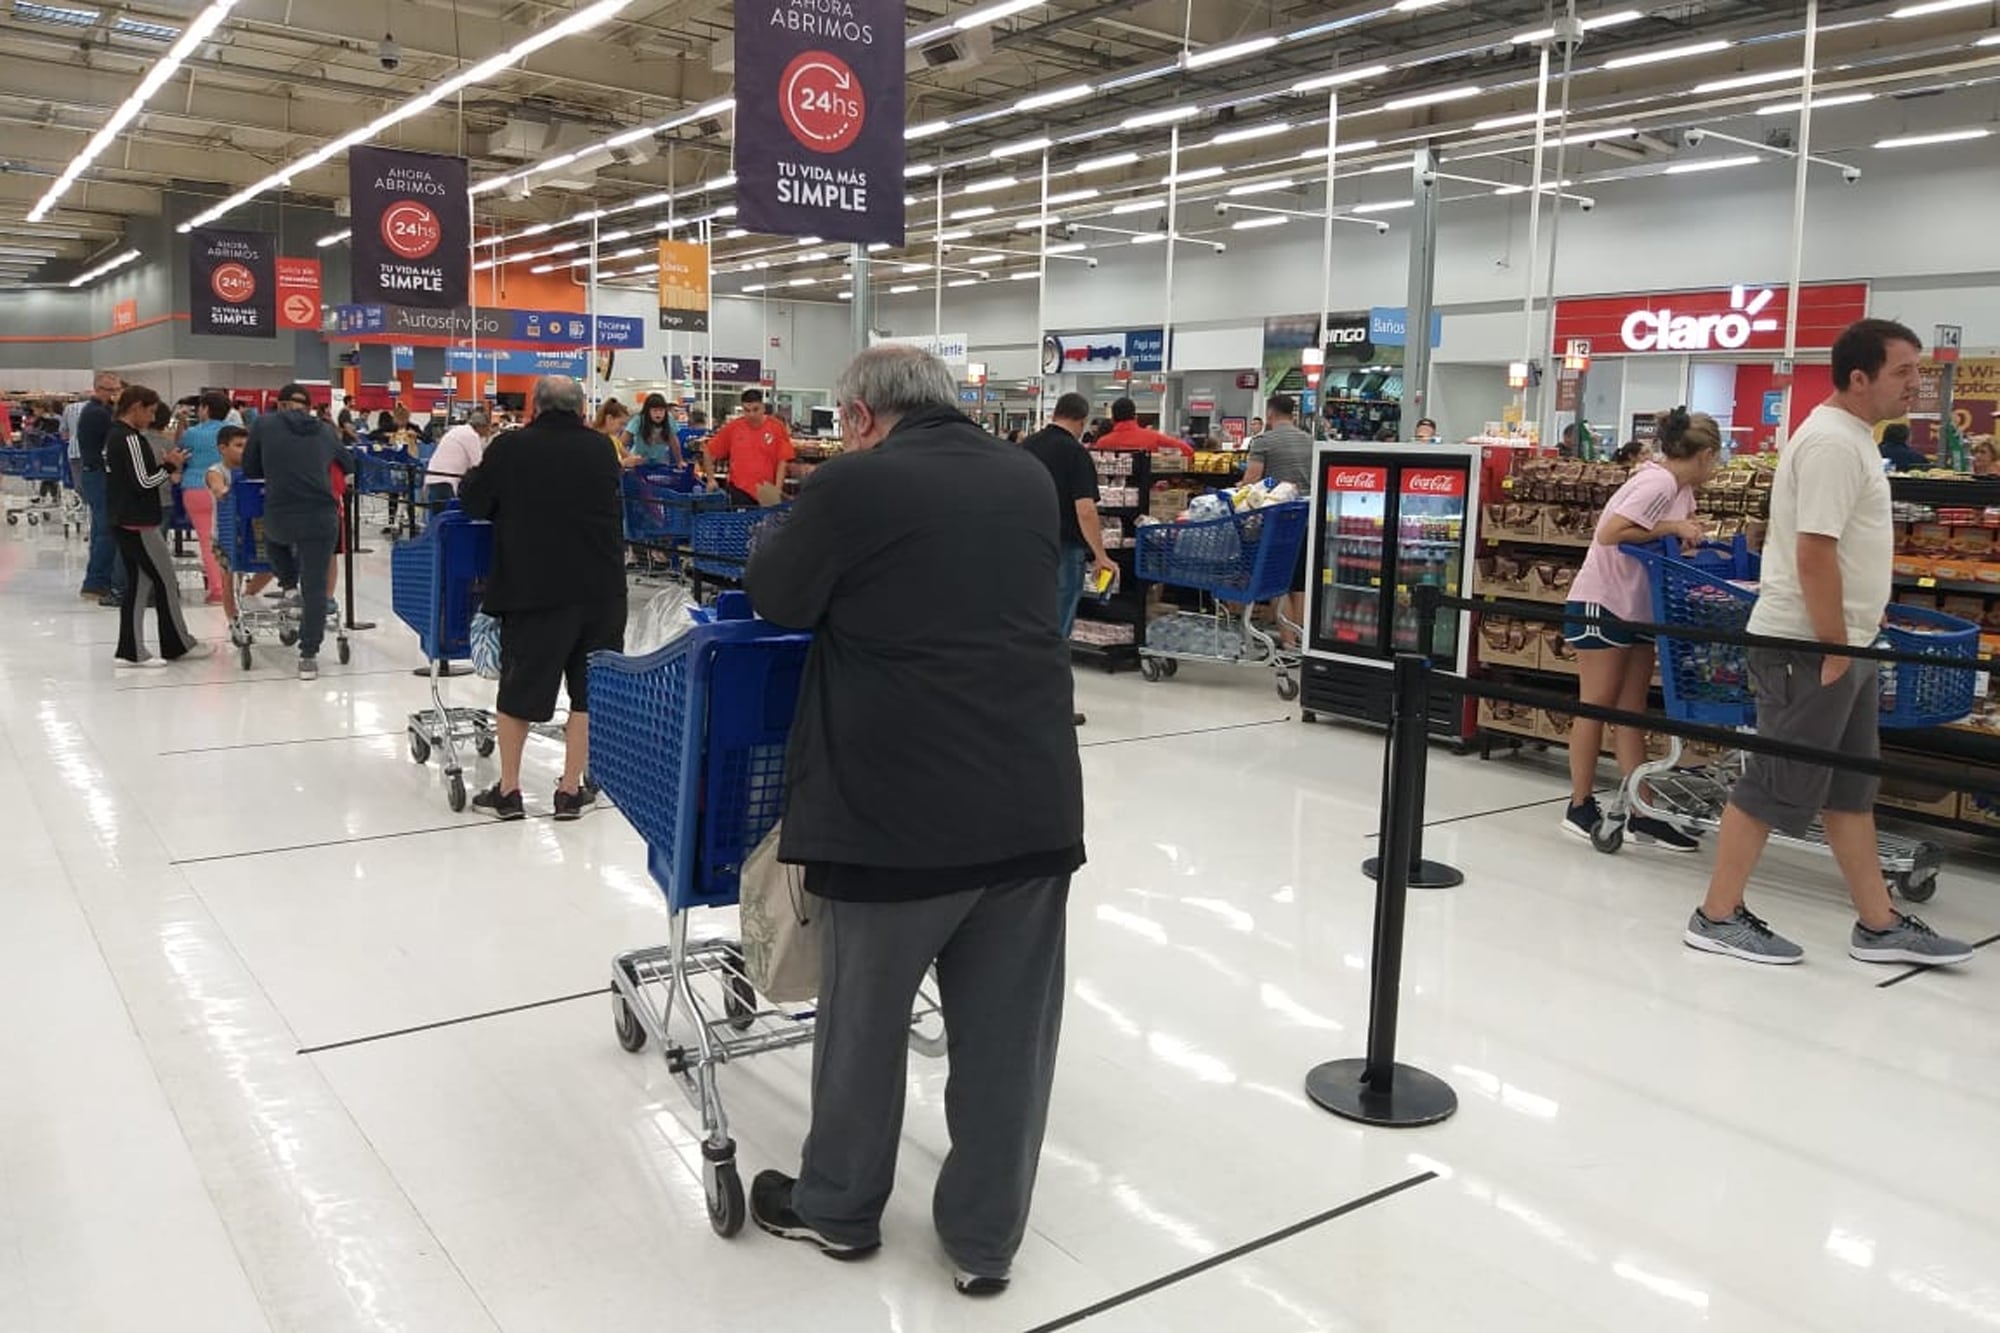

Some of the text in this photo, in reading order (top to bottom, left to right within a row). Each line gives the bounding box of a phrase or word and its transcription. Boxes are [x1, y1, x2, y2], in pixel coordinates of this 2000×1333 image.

[791, 0, 853, 17] AHORA
[770, 8, 873, 44] ABRIMOS
[801, 88, 858, 117] 24hs
[388, 168, 432, 180] AHORA
[778, 162, 867, 186] TU VIDA MÁS
[374, 178, 446, 195] ABRIMOS
[777, 179, 867, 211] SIMPLE
[395, 221, 436, 239] 24hs
[380, 264, 442, 276] TU VIDA MÁS
[380, 274, 443, 291] SIMPLE
[211, 314, 259, 325] SIMPLE
[398, 309, 500, 333] Autoservcio
[1374, 318, 1405, 334] Baños
[1621, 309, 1751, 350] Claro
[1576, 343, 1588, 355] 12
